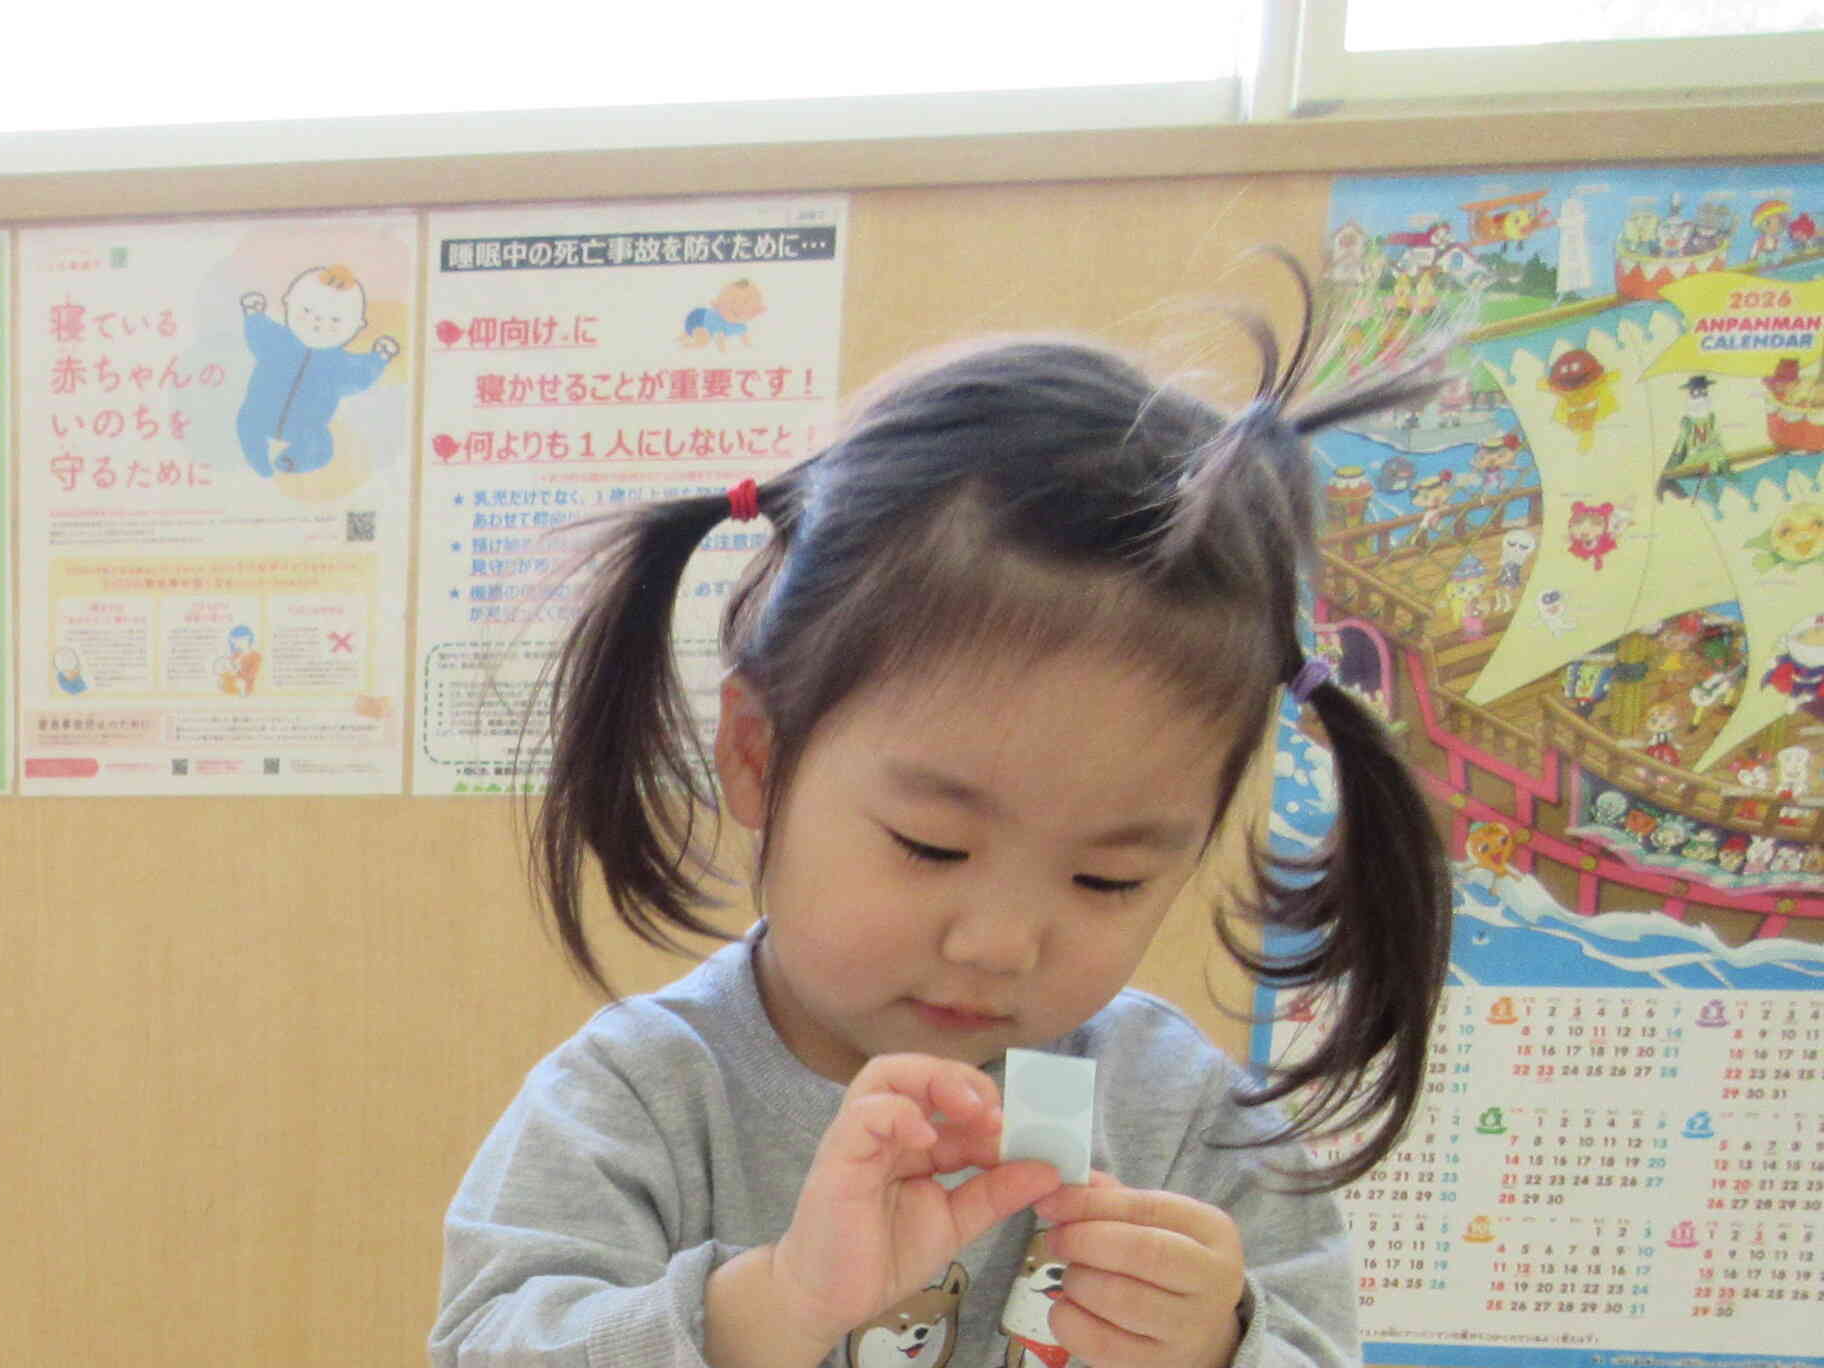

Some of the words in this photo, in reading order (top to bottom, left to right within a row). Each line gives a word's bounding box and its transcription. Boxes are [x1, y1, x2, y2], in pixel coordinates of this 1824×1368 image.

[1730, 290, 1793, 309] 2026
[49, 302, 178, 343] 寝ている
[1695, 316, 1821, 333] ANPANMAN
[1701, 333, 1814, 351] CALENDAR
[49, 355, 226, 394] 赤ちゃんの
[51, 404, 191, 440] いのちを
[49, 452, 213, 492] 守るために
[1569, 1026, 1584, 1037] 10
[1593, 1026, 1606, 1037] 11
[1617, 1026, 1632, 1037] 12
[1642, 1026, 1656, 1038] 13
[1541, 1045, 1556, 1056] 16
[1567, 1045, 1582, 1056] 17
[1591, 1045, 1604, 1056] 18
[1615, 1046, 1629, 1056] 19
[1637, 1046, 1655, 1057] 20
[1537, 1065, 1554, 1078] 23
[1562, 1065, 1579, 1076] 24
[1586, 1065, 1603, 1076] 25
[1610, 1066, 1627, 1077] 26
[1634, 1066, 1652, 1077] 27
[1579, 1136, 1594, 1147] 10
[1604, 1136, 1616, 1147] 11
[1628, 1137, 1643, 1148] 12
[1398, 1153, 1411, 1162] 14
[1421, 1153, 1435, 1163] 15
[1529, 1155, 1543, 1166] 15
[1554, 1156, 1567, 1166] 16
[1577, 1156, 1591, 1167] 17
[1601, 1156, 1615, 1167] 18
[1626, 1157, 1640, 1167] 19
[1370, 1171, 1387, 1182] 20
[1394, 1171, 1409, 1182] 21
[1418, 1172, 1434, 1183] 22
[1526, 1175, 1542, 1185] 22
[1550, 1175, 1565, 1185] 23
[1573, 1176, 1589, 1186] 24
[1596, 1176, 1616, 1186] 25
[1621, 1176, 1638, 1187] 26
[1344, 1189, 1361, 1200] 26
[1368, 1190, 1384, 1200] 27
[1392, 1190, 1408, 1200] 28
[1416, 1191, 1432, 1201] 29
[1523, 1193, 1540, 1204] 29
[1547, 1194, 1564, 1205] 30
[1388, 1240, 1403, 1250] 10
[1413, 1240, 1425, 1250] 11
[1364, 1258, 1377, 1269] 16
[1386, 1258, 1400, 1269] 17
[1410, 1259, 1424, 1270] 18
[1517, 1263, 1531, 1276] 12
[1541, 1264, 1555, 1274] 13
[1564, 1264, 1578, 1274] 14
[1588, 1264, 1601, 1275] 15
[1612, 1265, 1626, 1275] 16
[1361, 1277, 1375, 1290] 23
[1383, 1278, 1400, 1288] 24
[1406, 1278, 1422, 1289] 25
[1515, 1281, 1528, 1291] 19
[1537, 1283, 1554, 1293] 20
[1560, 1283, 1575, 1294] 21
[1584, 1284, 1599, 1294] 22
[1608, 1284, 1624, 1294] 23
[1510, 1301, 1527, 1311] 26
[1534, 1301, 1552, 1312] 27
[1558, 1301, 1574, 1312] 28
[1581, 1302, 1597, 1313] 29
[1604, 1302, 1623, 1314] 30
